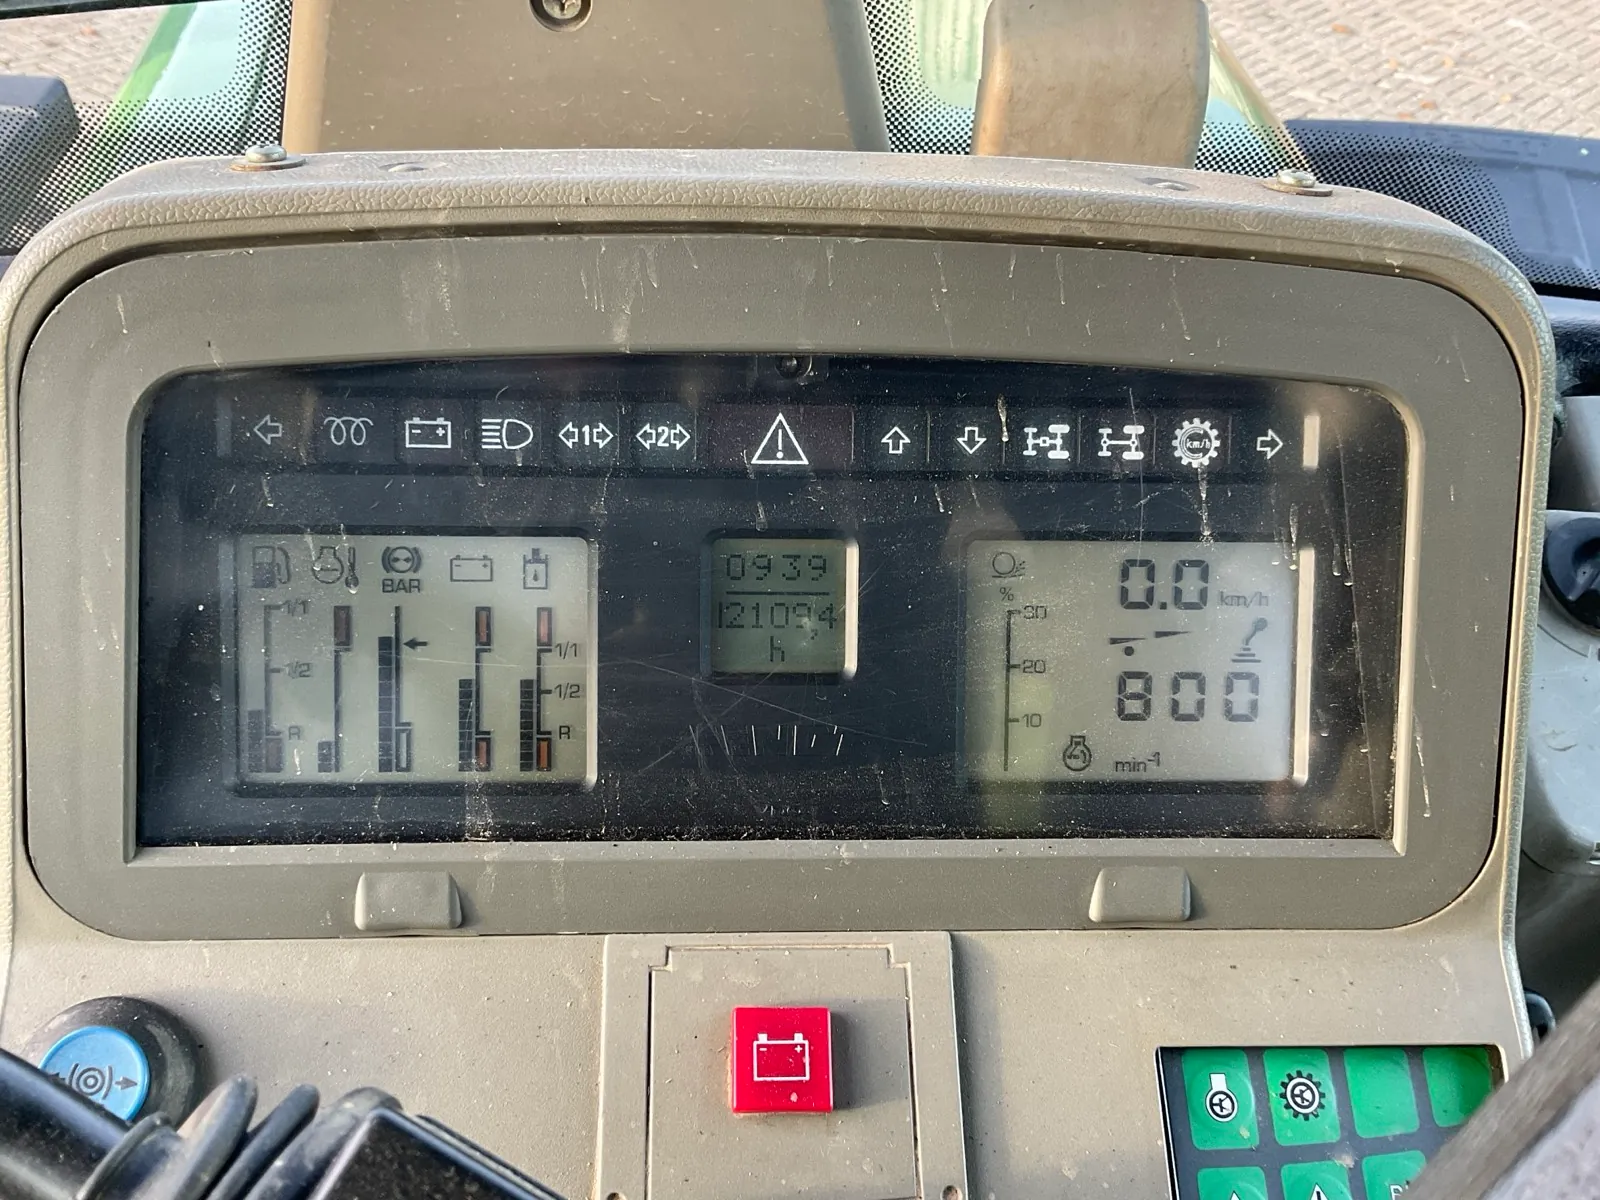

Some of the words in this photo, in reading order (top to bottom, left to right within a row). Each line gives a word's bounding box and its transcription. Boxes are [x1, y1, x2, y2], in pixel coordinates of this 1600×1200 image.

[582, 425, 590, 445] 1
[657, 425, 670, 447] 2
[381, 578, 421, 594] BAR
[1119, 558, 1210, 611] 0.0
[999, 586, 1015, 602] %
[1217, 590, 1270, 607] km/h
[1022, 604, 1048, 620] 30
[554, 642, 579, 658] 1/1
[769, 635, 786, 663] h
[1022, 659, 1047, 675] 20
[554, 683, 582, 700] 1/2
[1116, 670, 1261, 722] 800
[1022, 712, 1042, 728] 10
[287, 724, 303, 741] R
[558, 724, 572, 741] R
